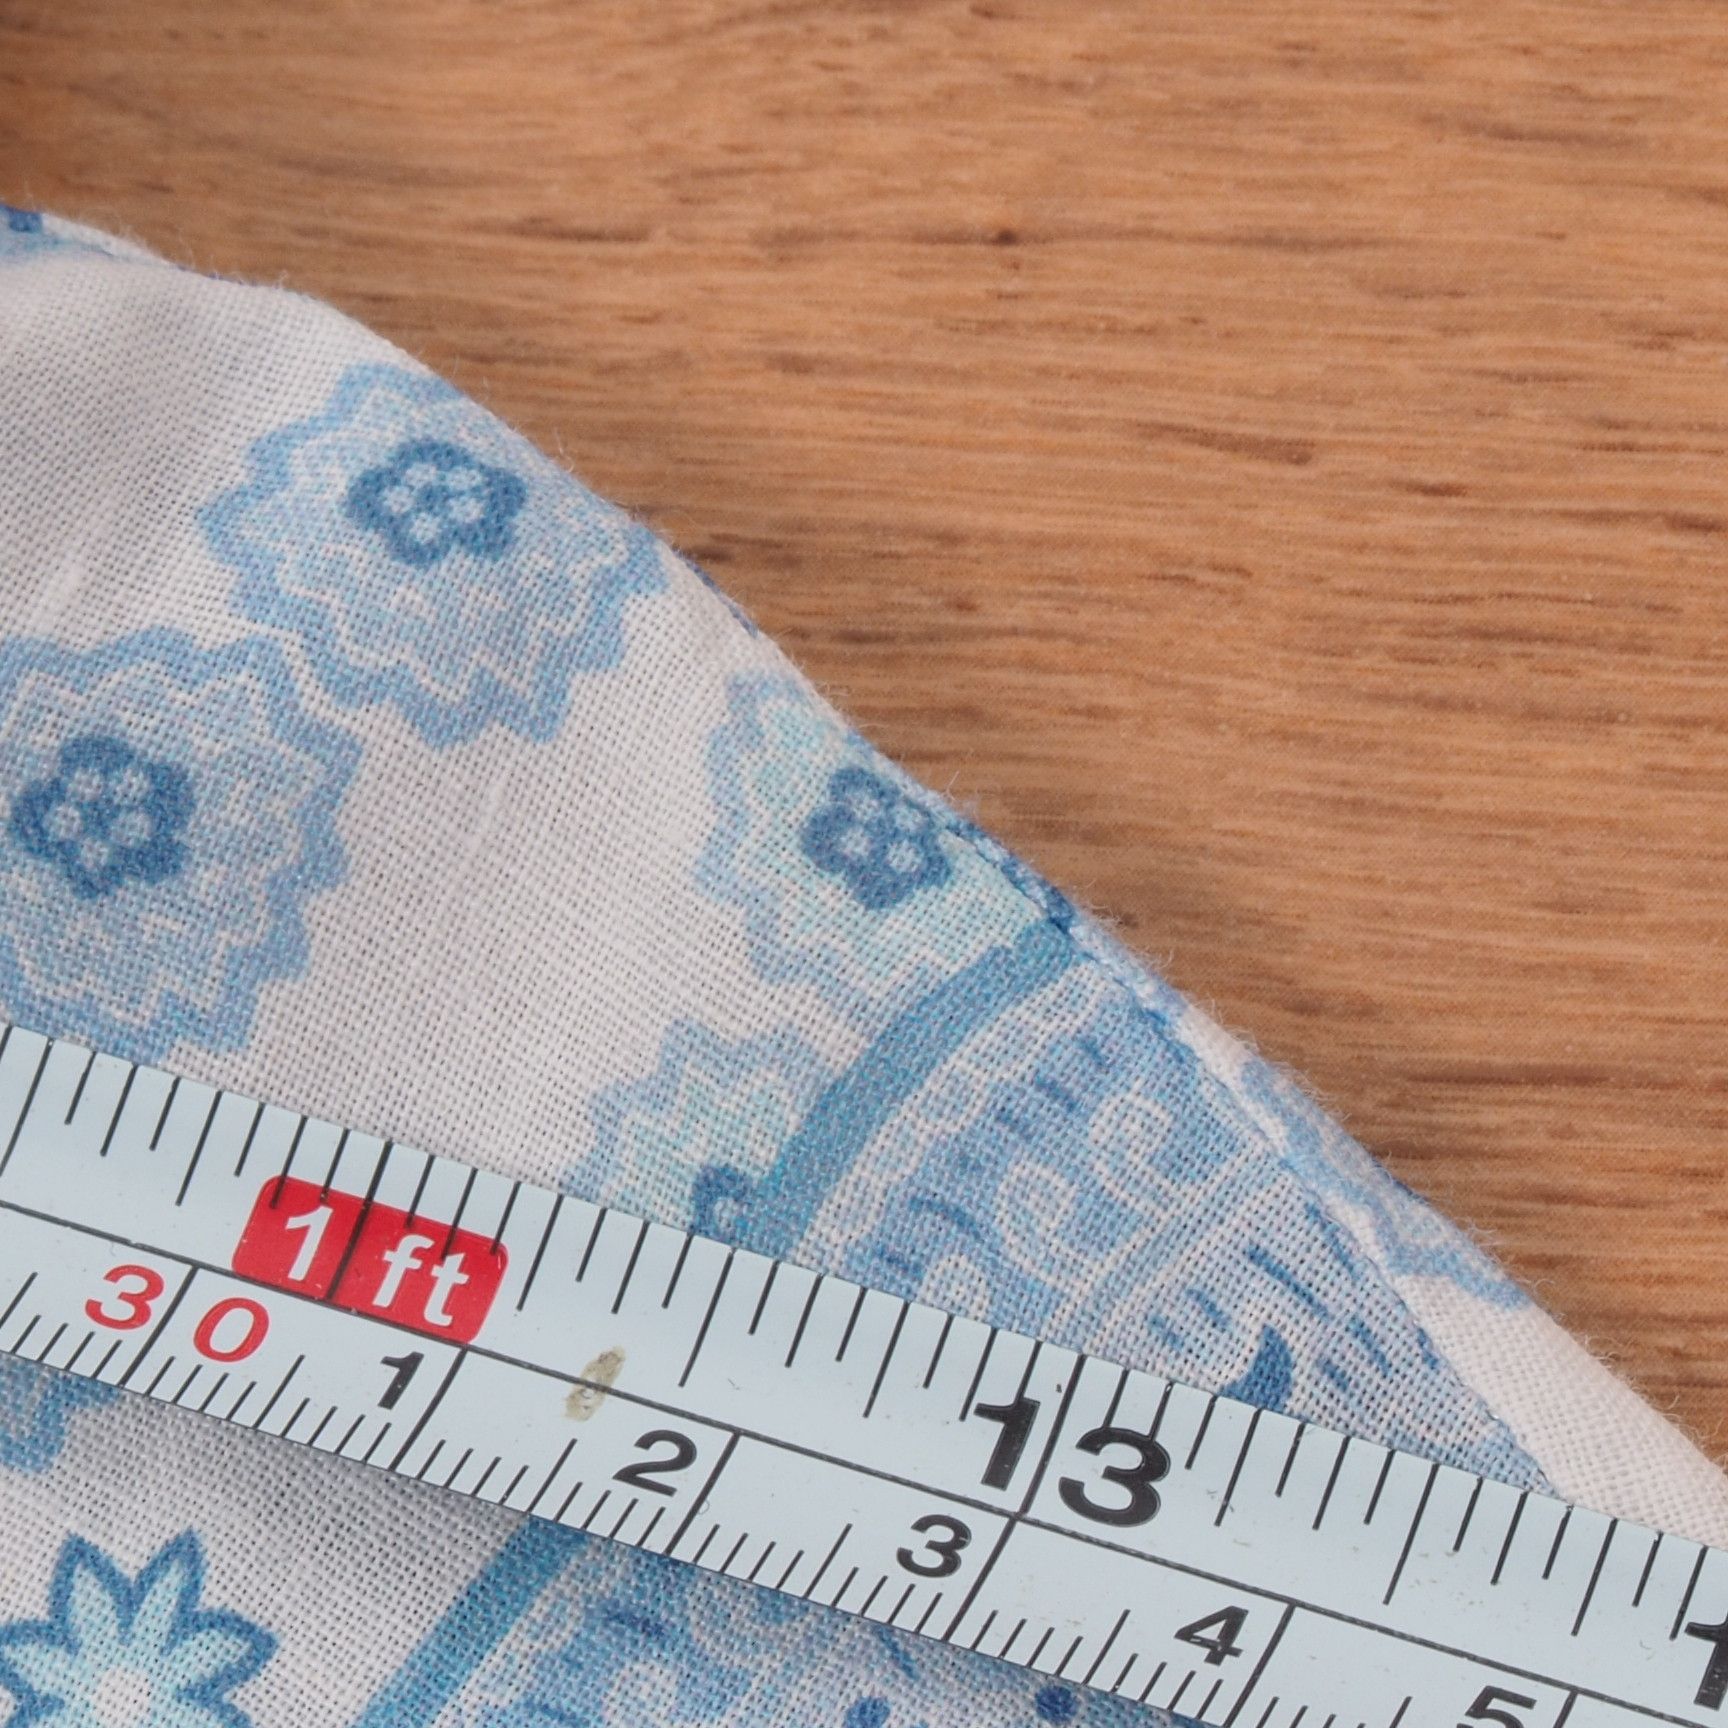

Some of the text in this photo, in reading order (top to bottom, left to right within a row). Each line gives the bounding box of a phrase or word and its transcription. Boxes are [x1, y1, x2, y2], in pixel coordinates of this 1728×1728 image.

[280, 1204, 470, 1329] 1 ft
[84, 1264, 270, 1364] 30
[380, 1350, 425, 1411] 1
[613, 1430, 698, 1497] 2
[972, 1398, 1171, 1528] 13
[896, 1514, 972, 1579] 3
[1173, 1605, 1250, 1666] 4
